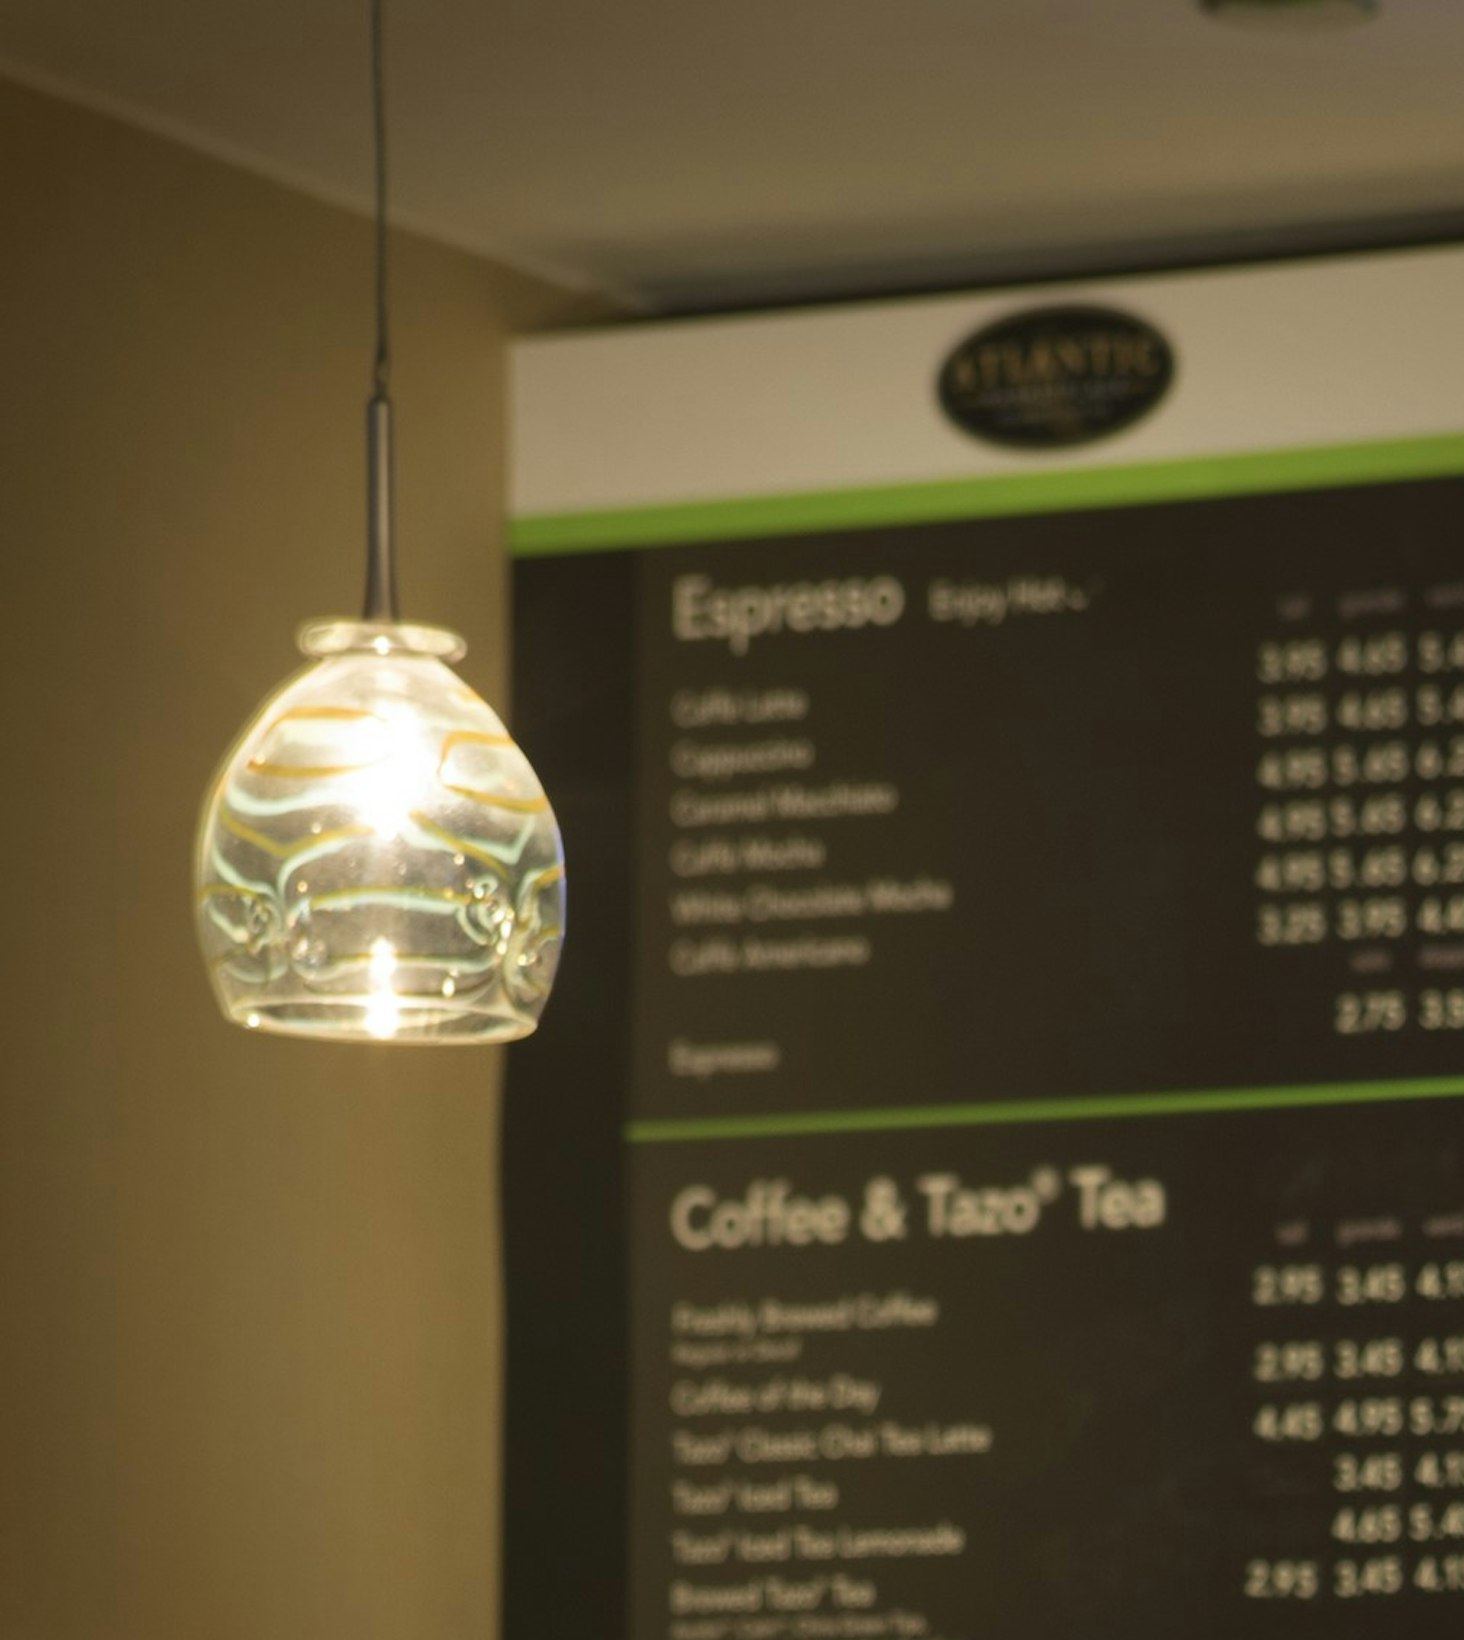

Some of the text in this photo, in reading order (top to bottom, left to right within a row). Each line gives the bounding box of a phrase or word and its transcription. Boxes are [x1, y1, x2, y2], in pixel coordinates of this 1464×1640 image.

[673, 574, 904, 656] Espresso
[672, 1177, 849, 1250] Coffee
[862, 1177, 905, 1241] &
[1070, 1166, 1165, 1230] Tea
